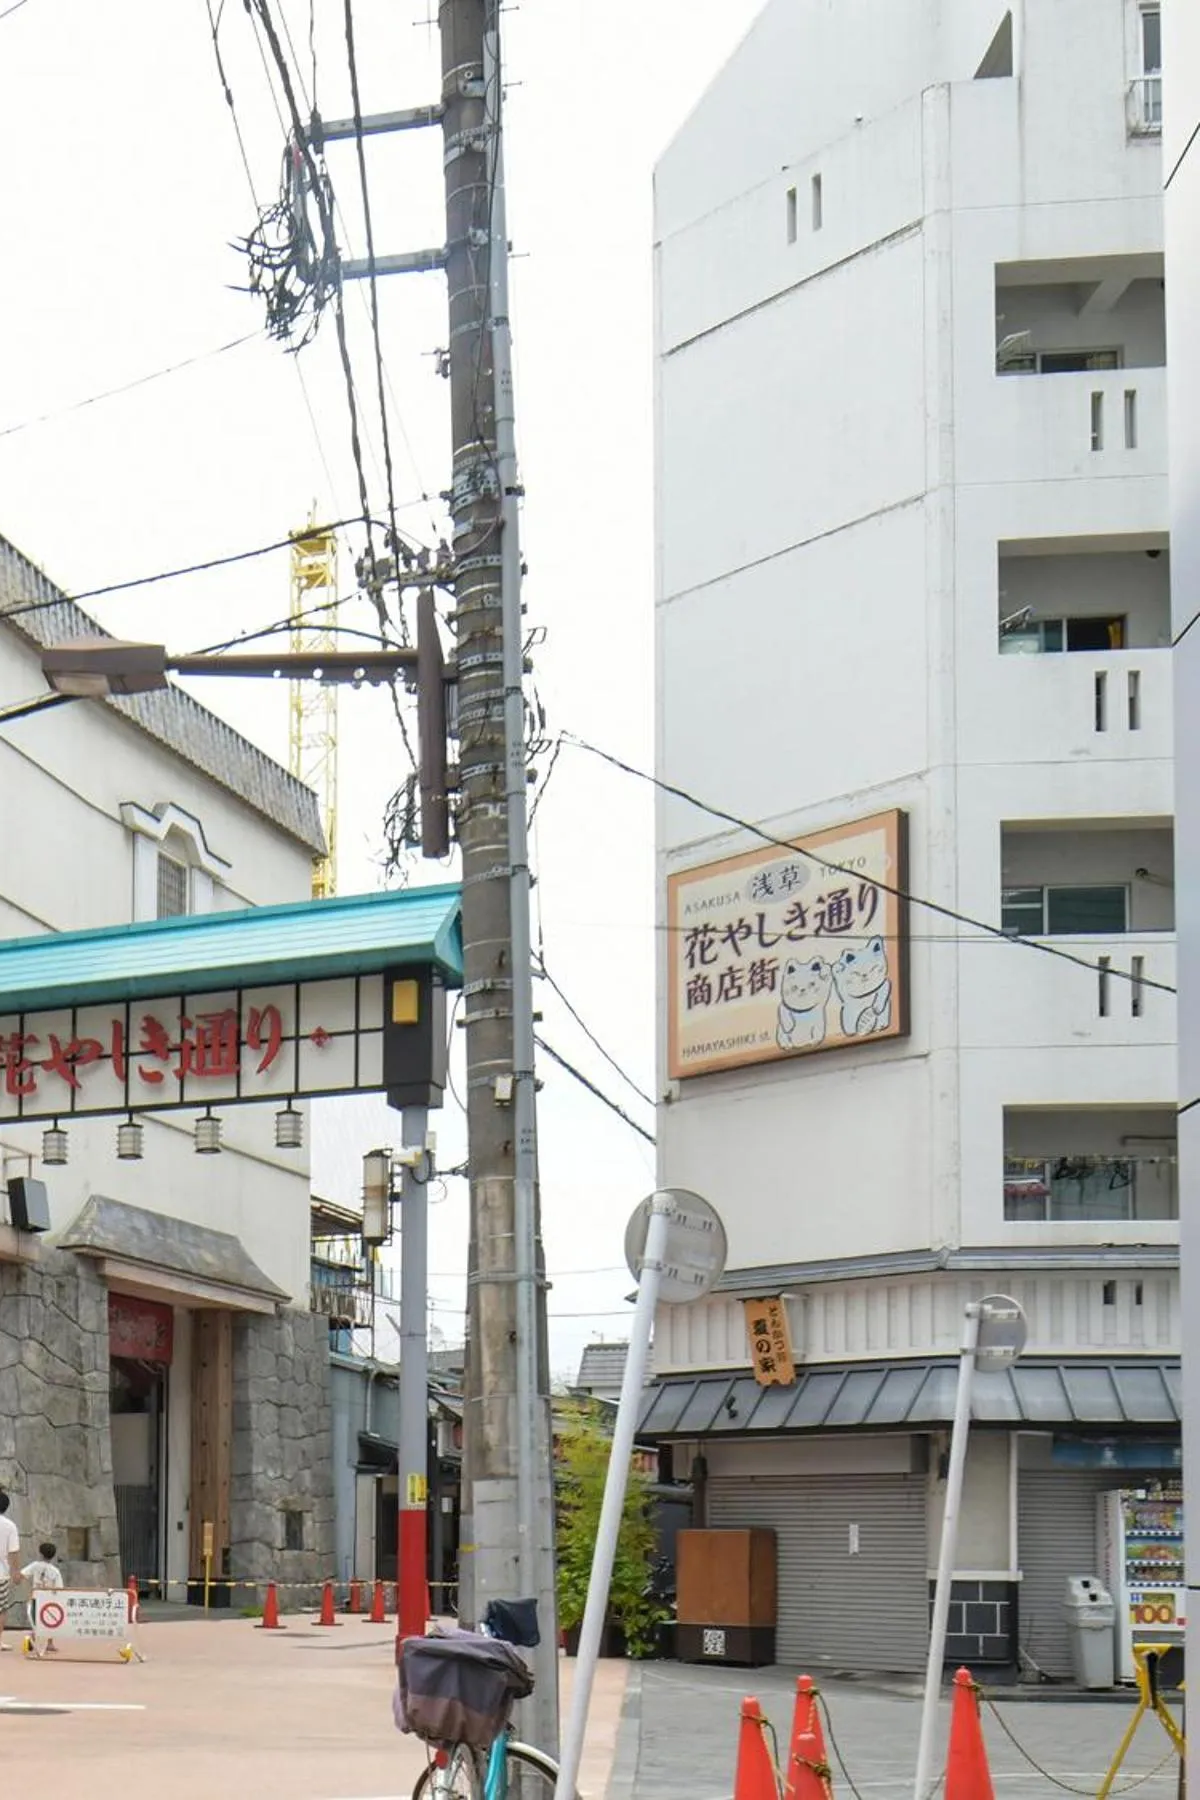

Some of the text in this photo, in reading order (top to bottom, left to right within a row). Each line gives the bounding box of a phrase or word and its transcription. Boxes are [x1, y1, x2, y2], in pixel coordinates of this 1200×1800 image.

[751, 863, 802, 899] 浅草
[820, 857, 866, 880] TOKYO
[685, 894, 741, 915] ASAKUSA
[684, 883, 879, 969] 花やしき通り
[686, 957, 780, 1010] 商店街
[1130, 1604, 1173, 1624] 100
